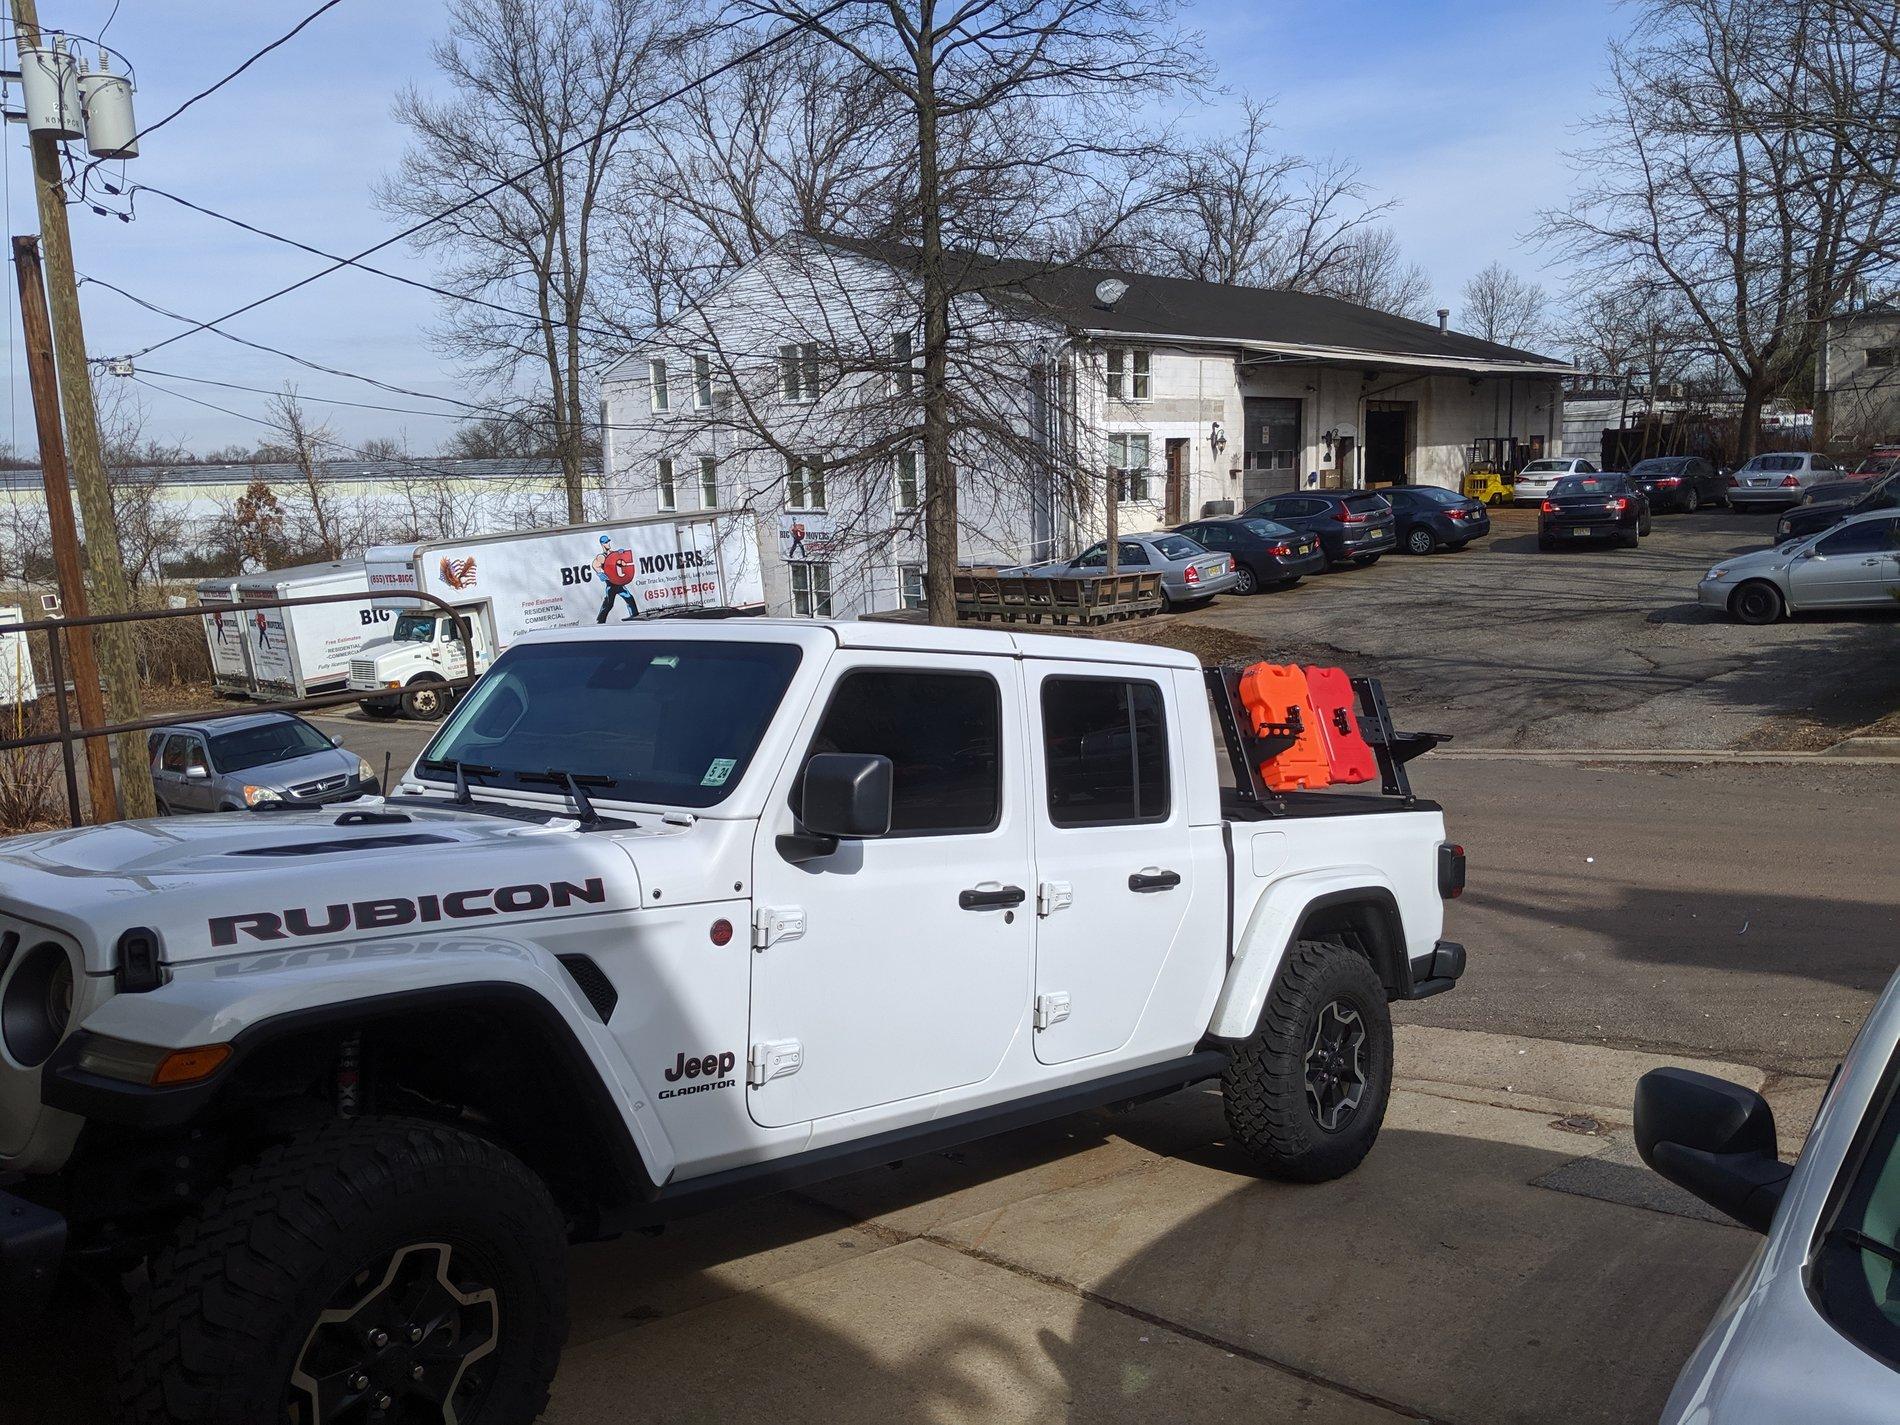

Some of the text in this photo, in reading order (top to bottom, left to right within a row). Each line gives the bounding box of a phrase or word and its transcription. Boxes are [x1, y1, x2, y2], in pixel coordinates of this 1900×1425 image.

[560, 564, 592, 586] BIG
[639, 550, 704, 575] MOVERS
[370, 574, 414, 585] (855) YES-BIGG
[644, 582, 715, 601] (855) YES-BIGG
[535, 596, 563, 606] Estimates
[359, 608, 390, 625] BIG
[524, 604, 564, 616] RESIDENTIAL
[524, 613, 565, 625] COMMERCIAL
[337, 635, 362, 644] Estimates
[208, 877, 606, 947] RUBICON
[664, 1051, 736, 1082] Jeep
[658, 1079, 736, 1100] GLADIATOR
